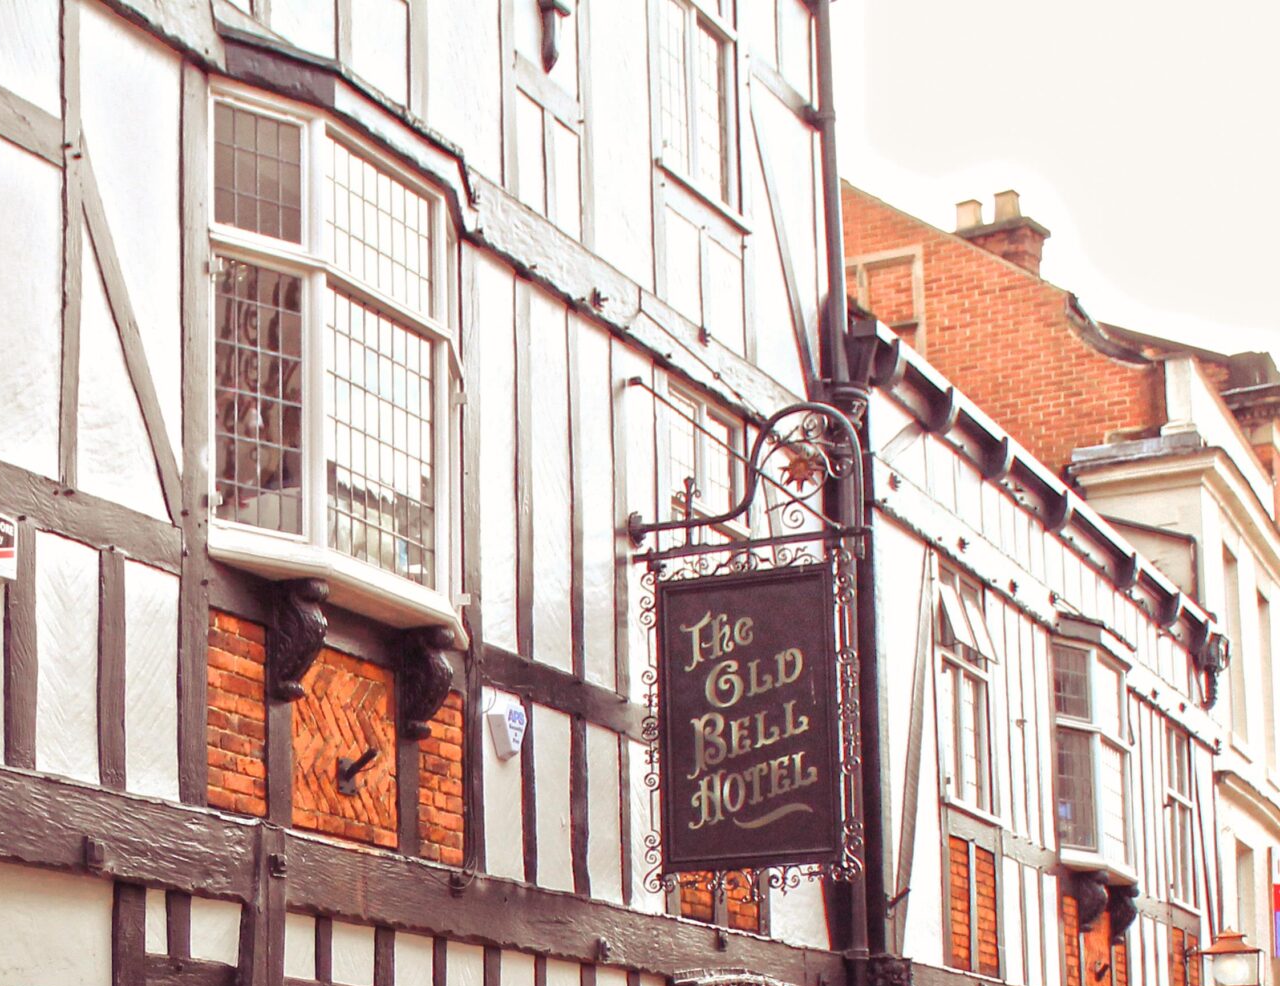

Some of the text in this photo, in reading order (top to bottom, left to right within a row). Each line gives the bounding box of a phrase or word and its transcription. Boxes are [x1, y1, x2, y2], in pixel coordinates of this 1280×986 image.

[679, 610, 755, 672] The
[704, 647, 804, 708] OLD
[686, 700, 810, 780] BELL
[688, 751, 819, 830] HOTEL
